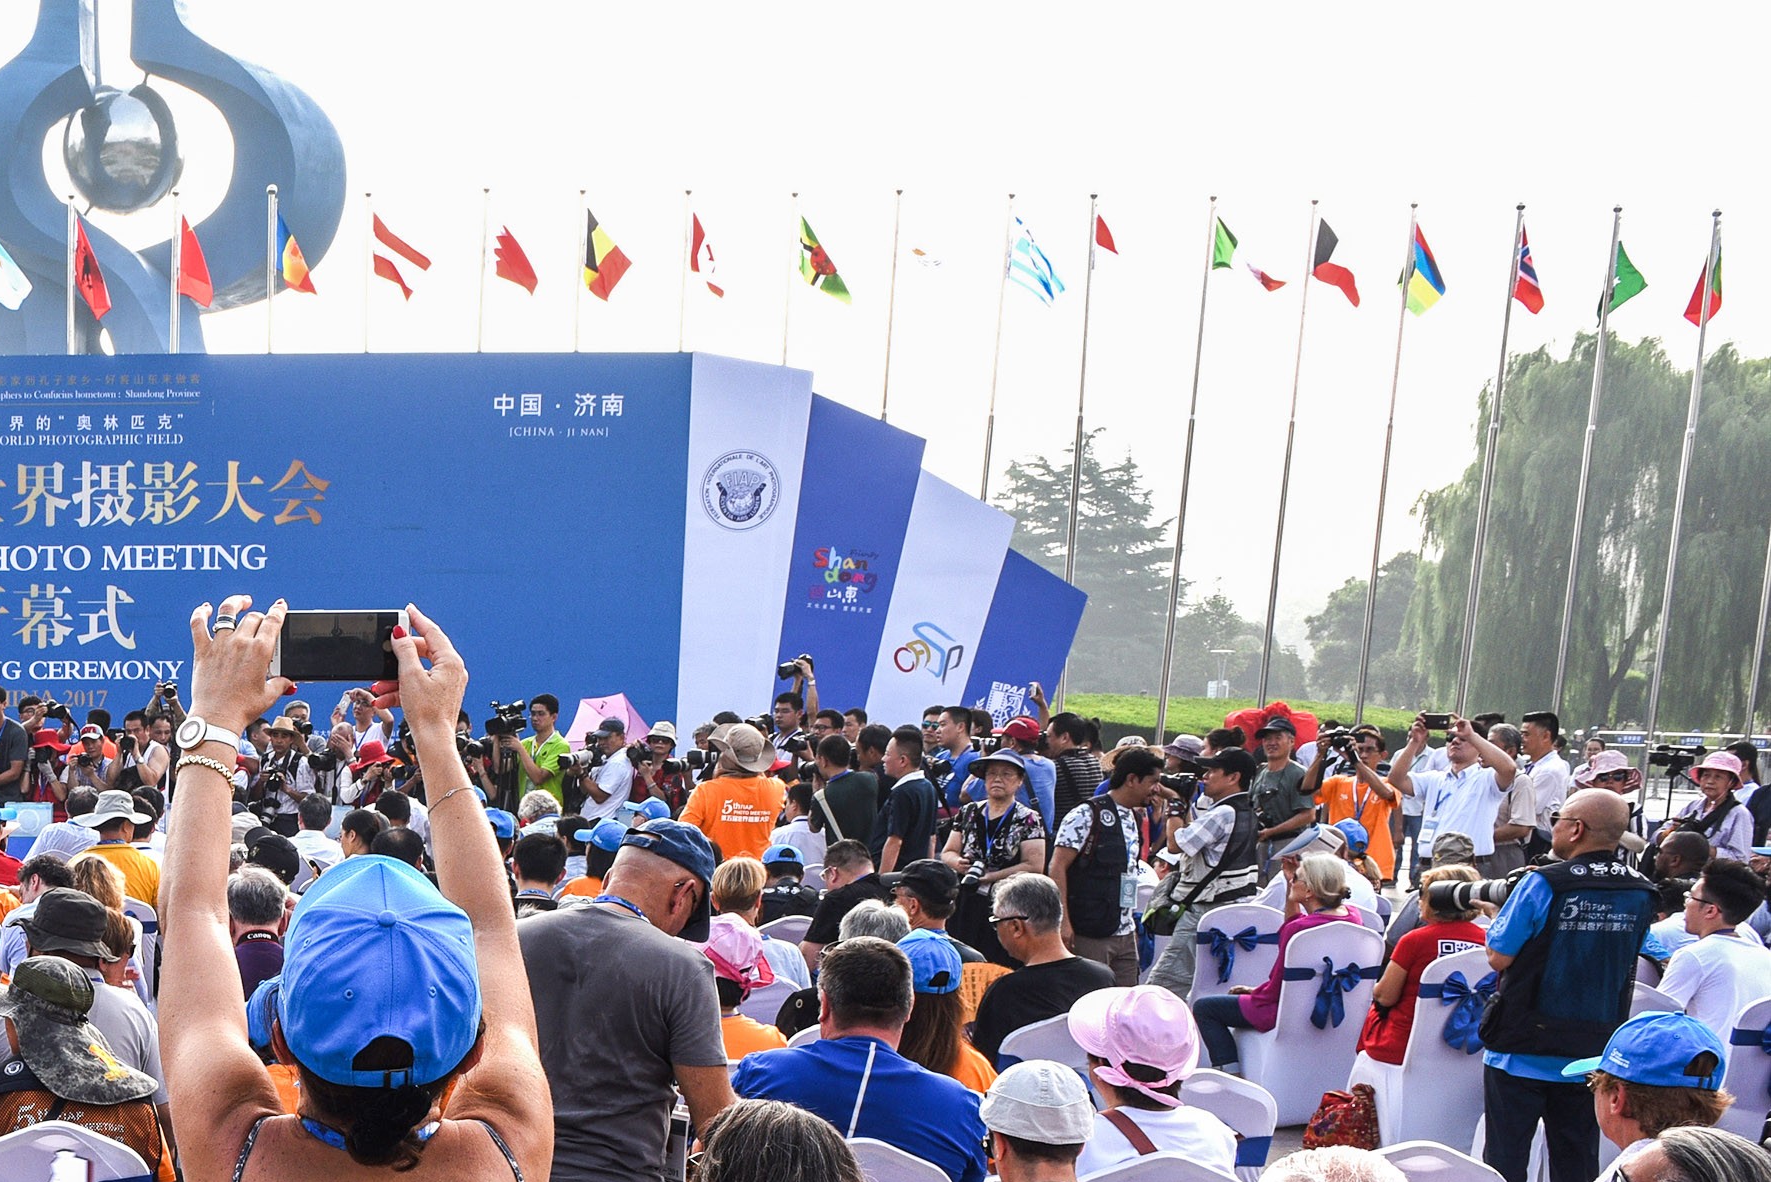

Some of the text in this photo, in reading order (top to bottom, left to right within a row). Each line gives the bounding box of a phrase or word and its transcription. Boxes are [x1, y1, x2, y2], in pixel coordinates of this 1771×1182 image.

[24, 391, 32, 400] to
[33, 389, 74, 400] Confucius
[125, 389, 165, 399] Shandong
[166, 388, 201, 398] Province
[38, 434, 143, 446] PHOTOGRAPHIC
[146, 433, 184, 445] FIELD
[101, 543, 268, 571] MEETING
[28, 659, 185, 681] CEREMONY
[992, 681, 1027, 696] EIPAA
[63, 690, 109, 708] 2017
